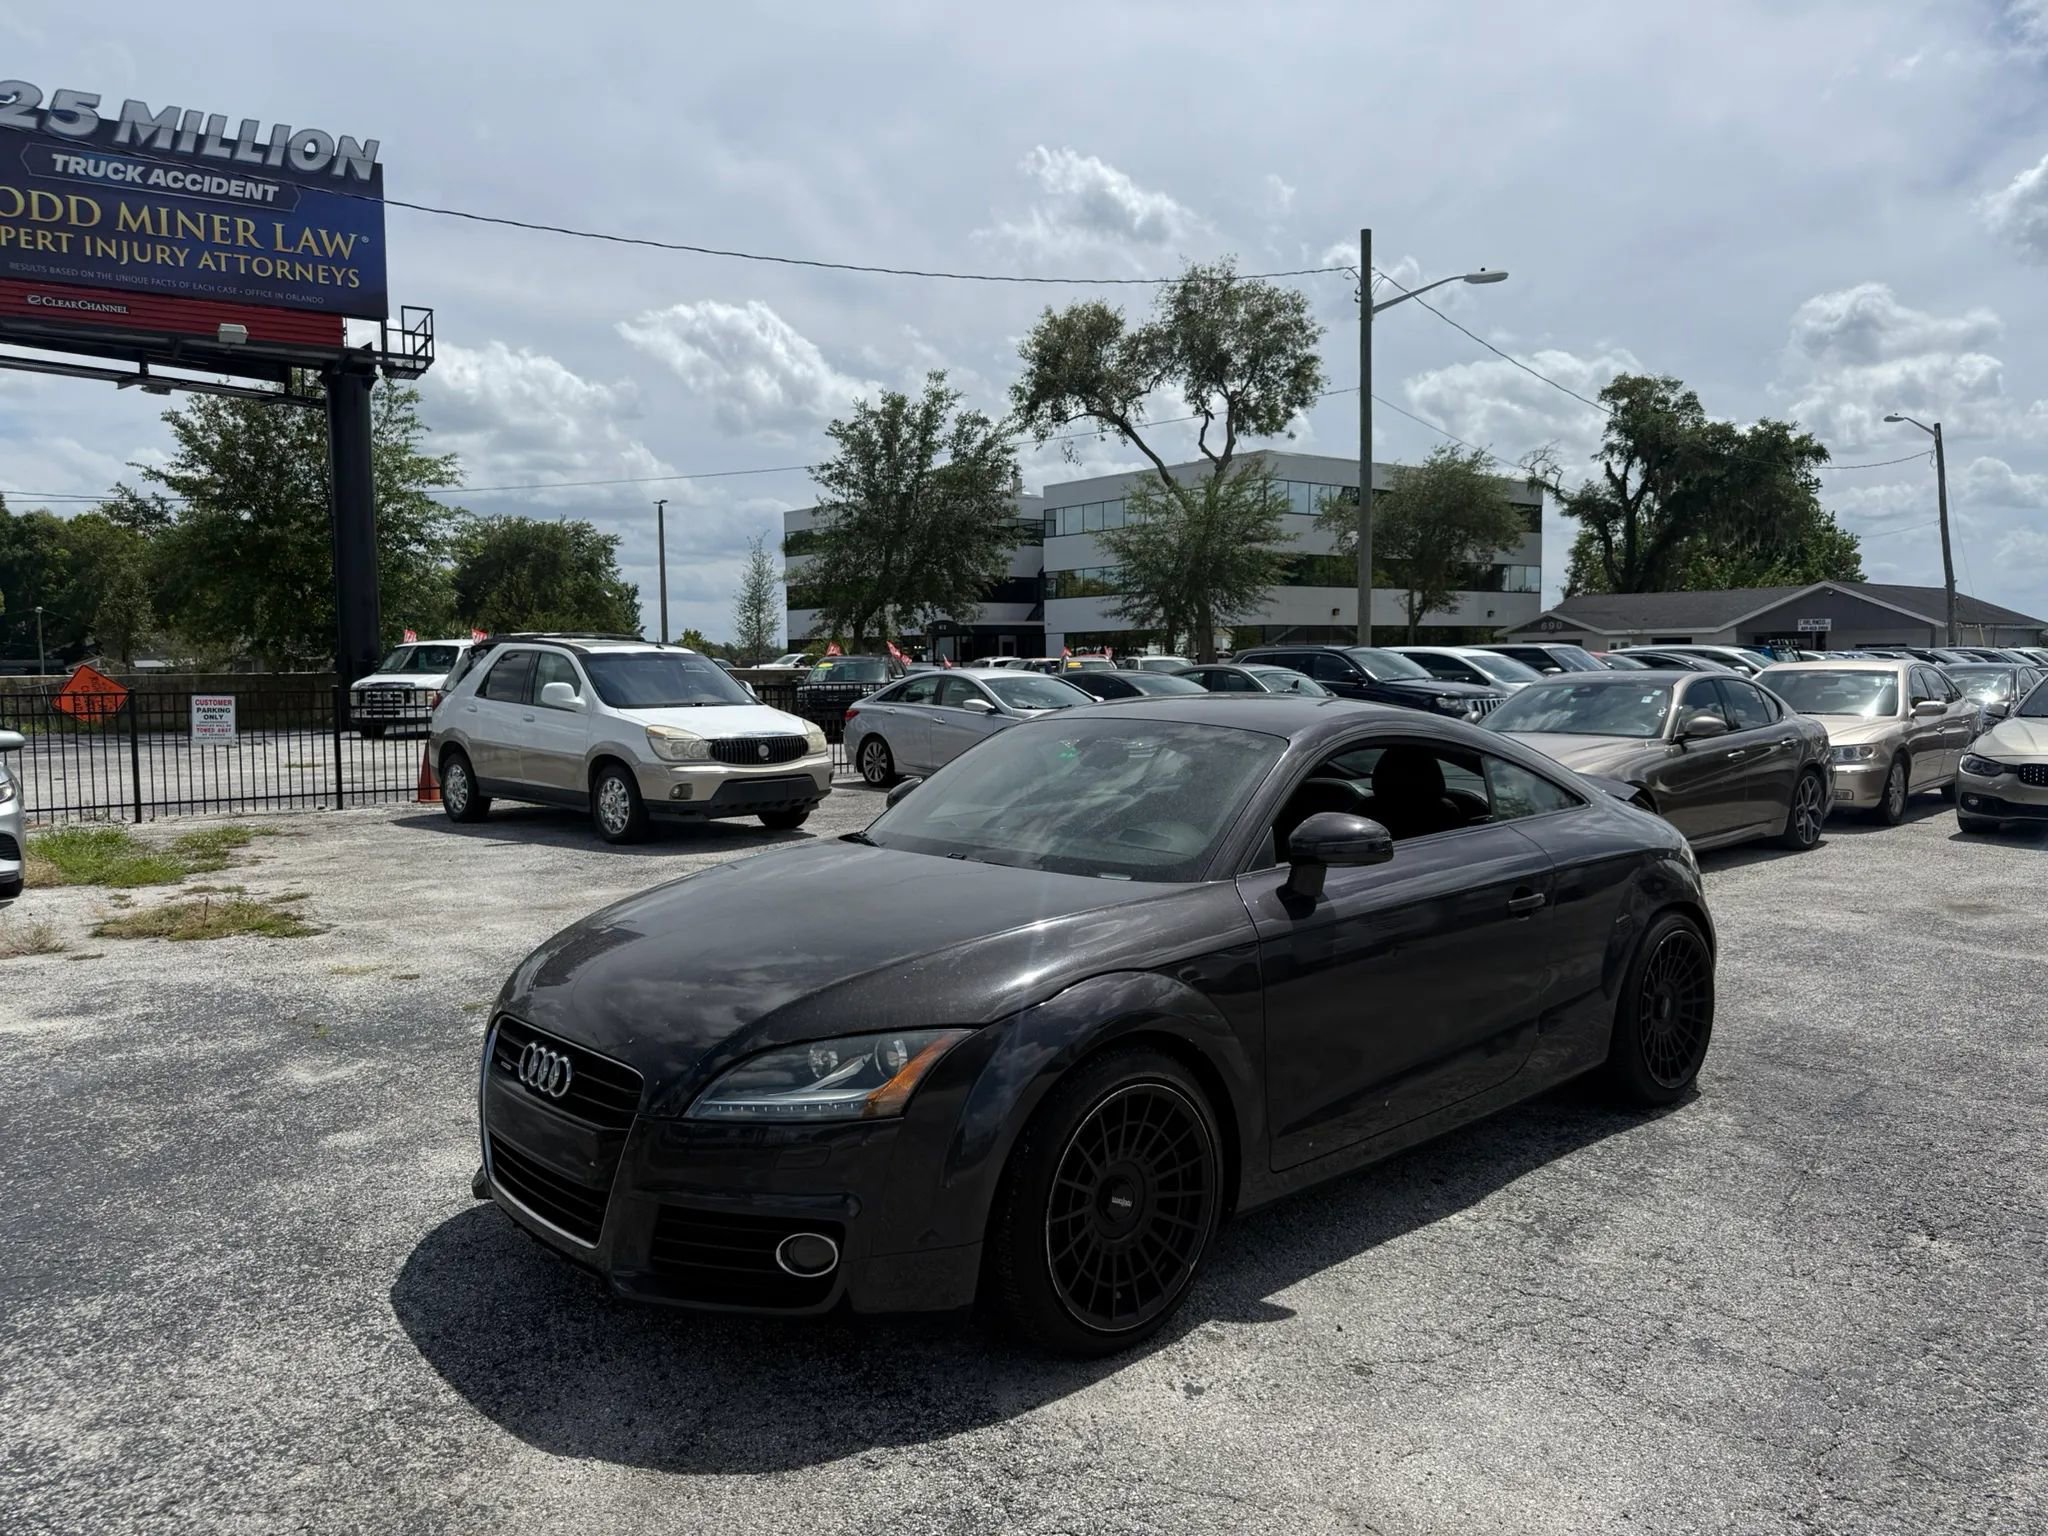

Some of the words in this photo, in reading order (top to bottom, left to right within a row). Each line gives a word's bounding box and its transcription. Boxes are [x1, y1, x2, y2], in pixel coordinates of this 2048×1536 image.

[0, 80, 101, 137] 25
[113, 99, 380, 182] MILLION
[52, 153, 145, 184] TRUCK
[147, 168, 280, 202] ACCIDENT
[115, 201, 264, 250] MINER
[0, 225, 74, 253] PERT
[85, 235, 190, 267] INJURY
[198, 250, 360, 288] ATTORNEYS
[9, 262, 47, 273] RESULTS
[50, 266, 79, 277] BASED
[80, 269, 95, 278] ON
[97, 271, 113, 280] THE
[115, 274, 149, 285] UNIQUE
[151, 278, 177, 288] FACTS
[179, 280, 190, 289] OF
[193, 282, 215, 292] EACH
[217, 285, 237, 295] CASE
[245, 288, 272, 298] OFFICE
[275, 291, 284, 299] IN
[285, 292, 325, 304] ORLANDO
[1541, 621, 1562, 630] 690
